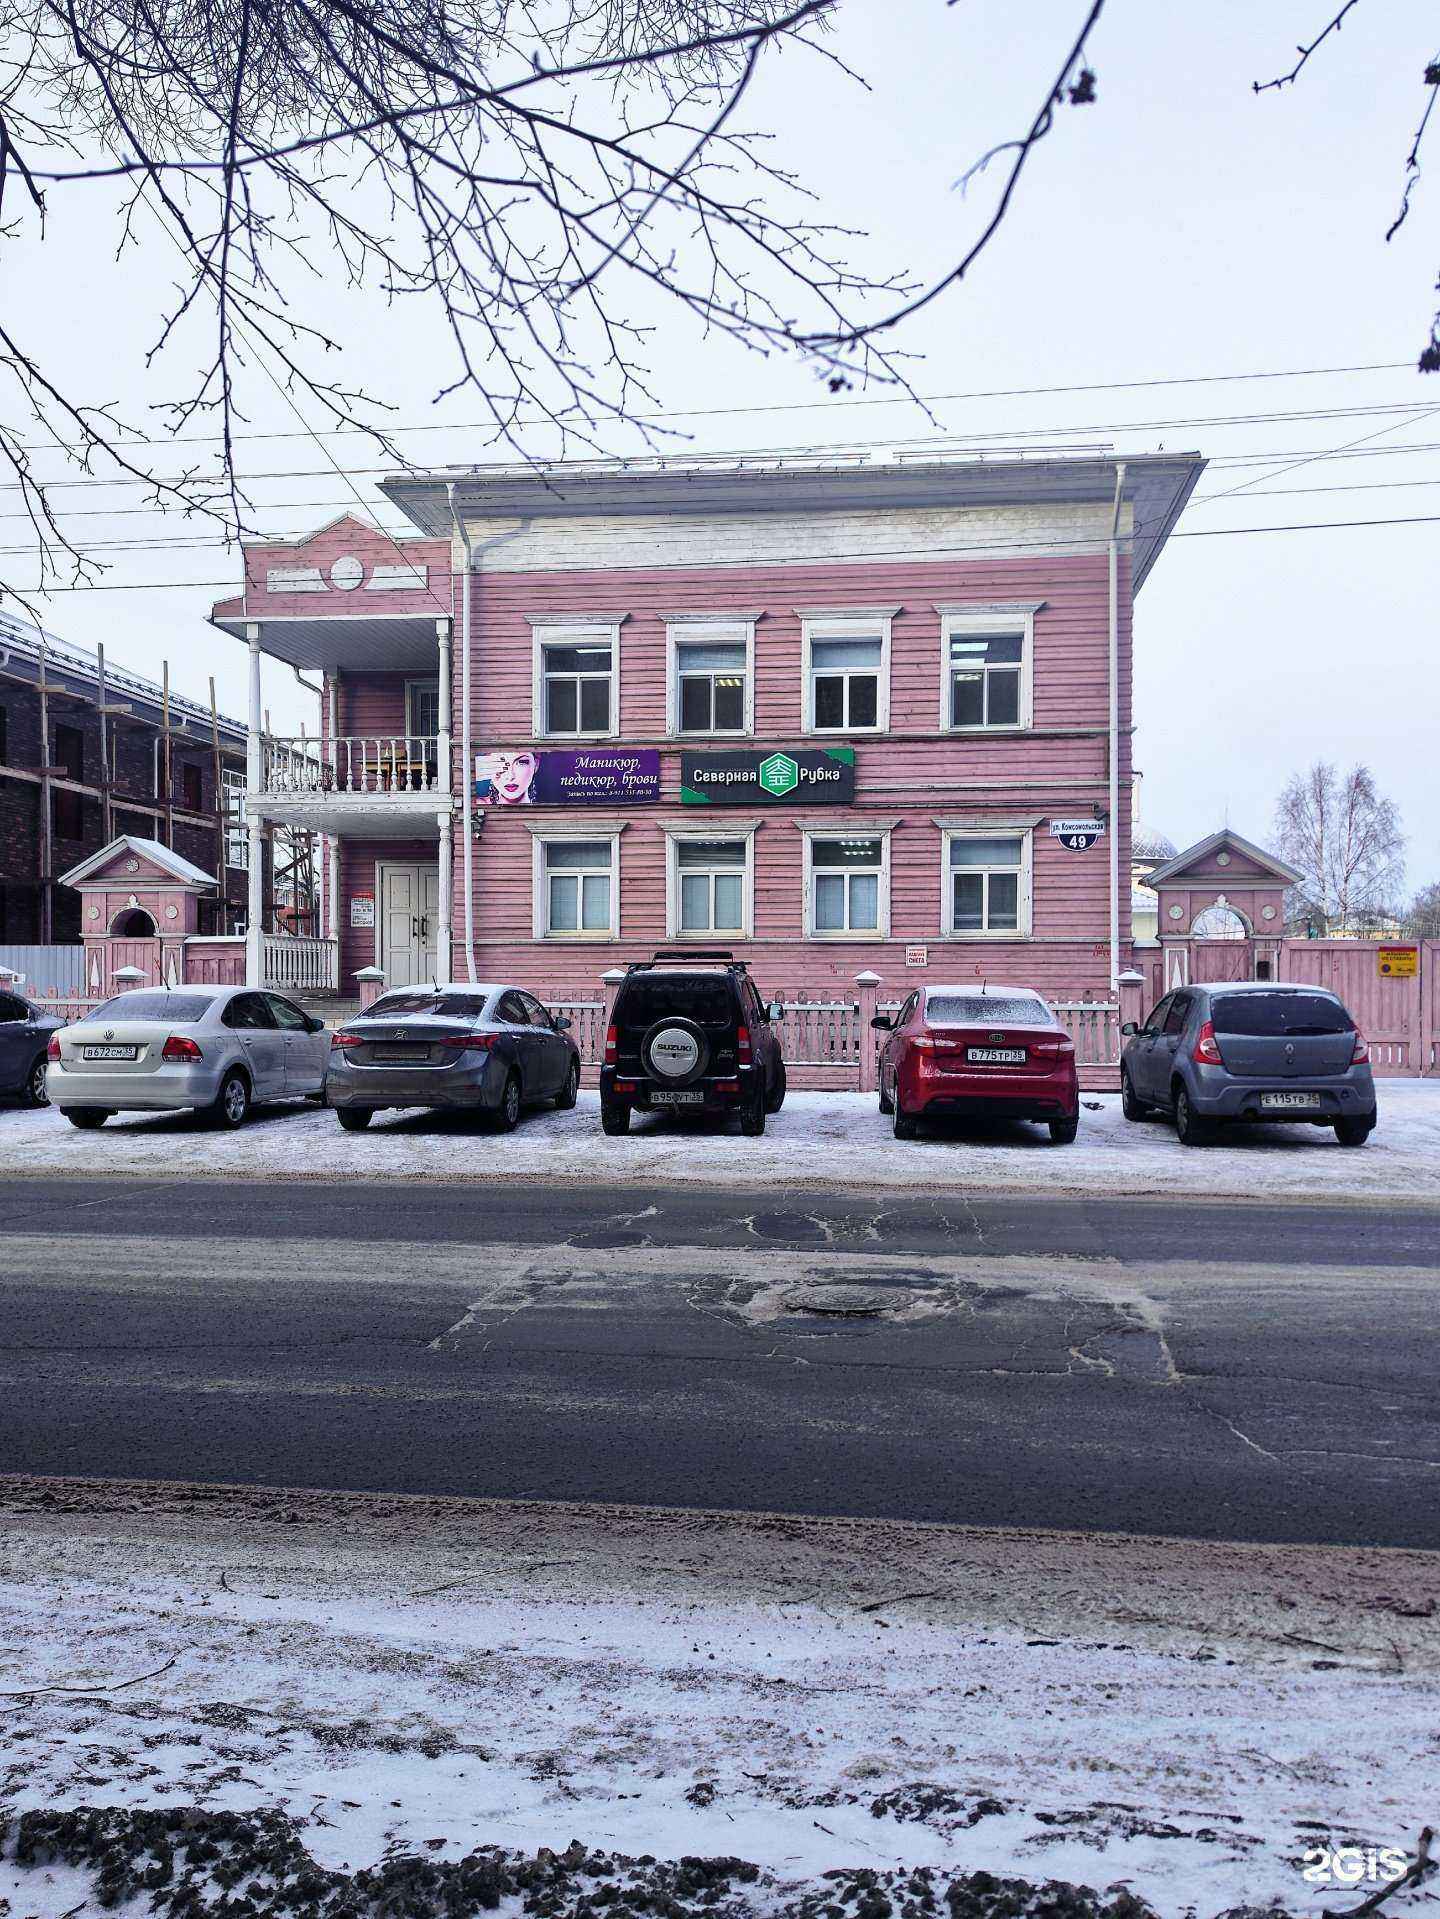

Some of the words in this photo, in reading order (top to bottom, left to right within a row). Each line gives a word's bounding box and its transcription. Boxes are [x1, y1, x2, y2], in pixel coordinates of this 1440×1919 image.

[575, 757, 641, 771] Маникюр,
[560, 771, 617, 788] педикюр,
[622, 770, 658, 788] брови
[693, 769, 757, 785] Северная
[800, 767, 840, 784] Рубка
[1062, 822, 1104, 831] Комсомольская
[1069, 835, 1086, 848] 49
[656, 1043, 693, 1052] SUZUKI
